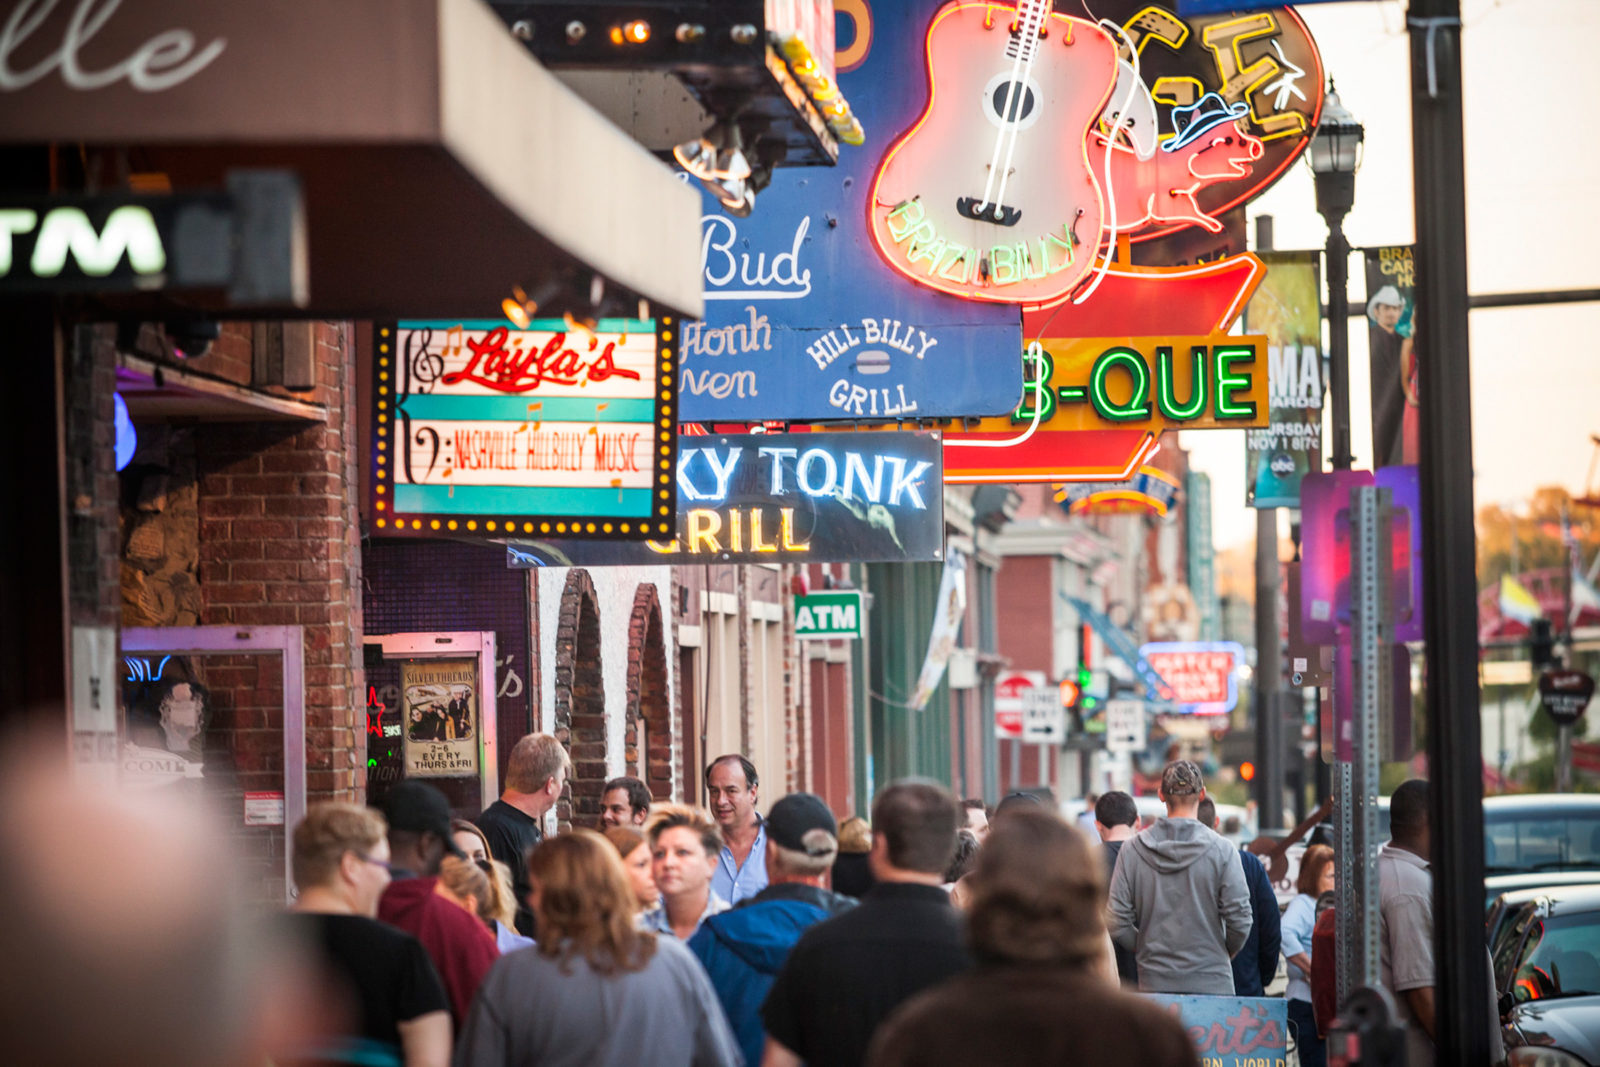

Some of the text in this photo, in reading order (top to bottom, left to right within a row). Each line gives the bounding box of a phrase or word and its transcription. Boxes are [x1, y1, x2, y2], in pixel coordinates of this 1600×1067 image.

[701, 213, 811, 299] Bud
[441, 325, 641, 394] Layla's
[806, 318, 938, 370] HILL BILLY
[829, 378, 918, 416] GRILL
[1269, 396, 1321, 409] ARDS
[454, 429, 641, 473] NASHVILLE HILLBILLY MUSIC
[1247, 437, 1279, 451] NOV
[758, 447, 934, 510] TONK
[1270, 458, 1296, 473] abc
[645, 506, 811, 554] RILL
[795, 604, 857, 631] ATM
[436, 671, 473, 683] THREADS
[415, 760, 448, 769] THURS
[456, 759, 472, 768] FRI
[422, 751, 461, 761] EVERY
[1167, 1002, 1286, 1054] ert's
